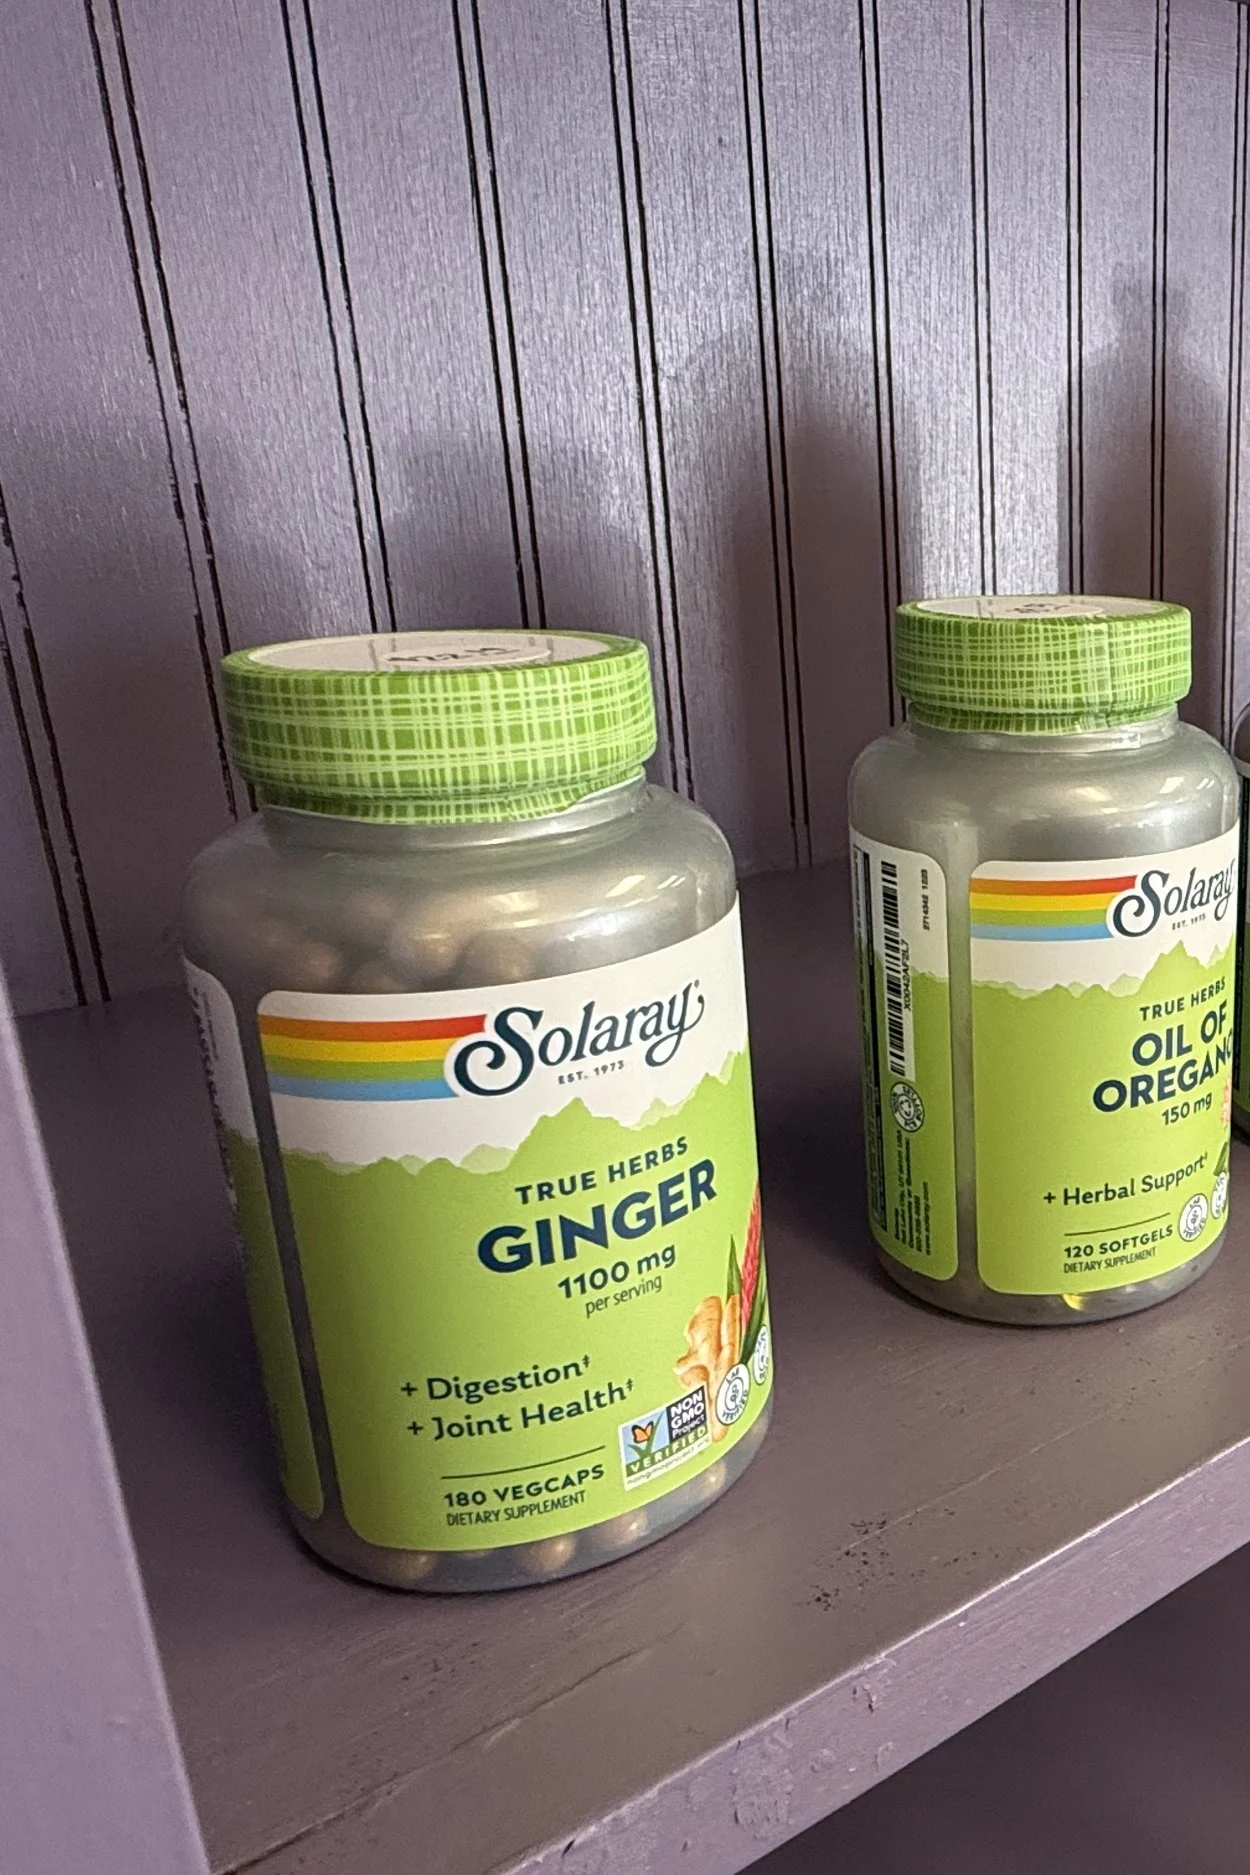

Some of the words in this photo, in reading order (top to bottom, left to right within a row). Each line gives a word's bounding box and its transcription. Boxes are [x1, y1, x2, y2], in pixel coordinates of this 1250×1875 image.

[1112, 858, 1236, 938] Solaray
[1140, 996, 1185, 1022] TRUE
[1190, 976, 1226, 1007] HERBS
[453, 979, 705, 1097] Solaray
[1131, 1023, 1193, 1067] OIL
[1200, 1000, 1228, 1044] OF
[558, 1070, 589, 1085] EST.
[594, 1059, 625, 1076] 1973
[1162, 1102, 1190, 1126] 150
[1193, 1092, 1213, 1114] mg
[515, 1170, 597, 1205] TRUE
[608, 1135, 689, 1183] HERBS
[1063, 1178, 1135, 1206] Herbal
[477, 1158, 718, 1274] GINGER
[1064, 1244, 1094, 1259] 120
[1099, 1224, 1174, 1255] SOFTGELS
[1064, 1261, 1103, 1274] DIETARY
[1105, 1246, 1157, 1269] SUPPLEMENT
[558, 1260, 630, 1299] 1100
[637, 1243, 677, 1276] mg
[585, 1297, 611, 1319] per
[613, 1274, 663, 1305] serving
[671, 1389, 703, 1418] NON
[671, 1404, 704, 1429] GMO
[434, 1412, 513, 1441] Joint
[672, 1415, 705, 1439] Project
[630, 1425, 706, 1473] VERIFIED
[444, 1489, 487, 1508] 180
[494, 1464, 605, 1501] VEGCAPS
[446, 1508, 501, 1527] DIETARY
[504, 1489, 586, 1521] SUPPLEMENT
